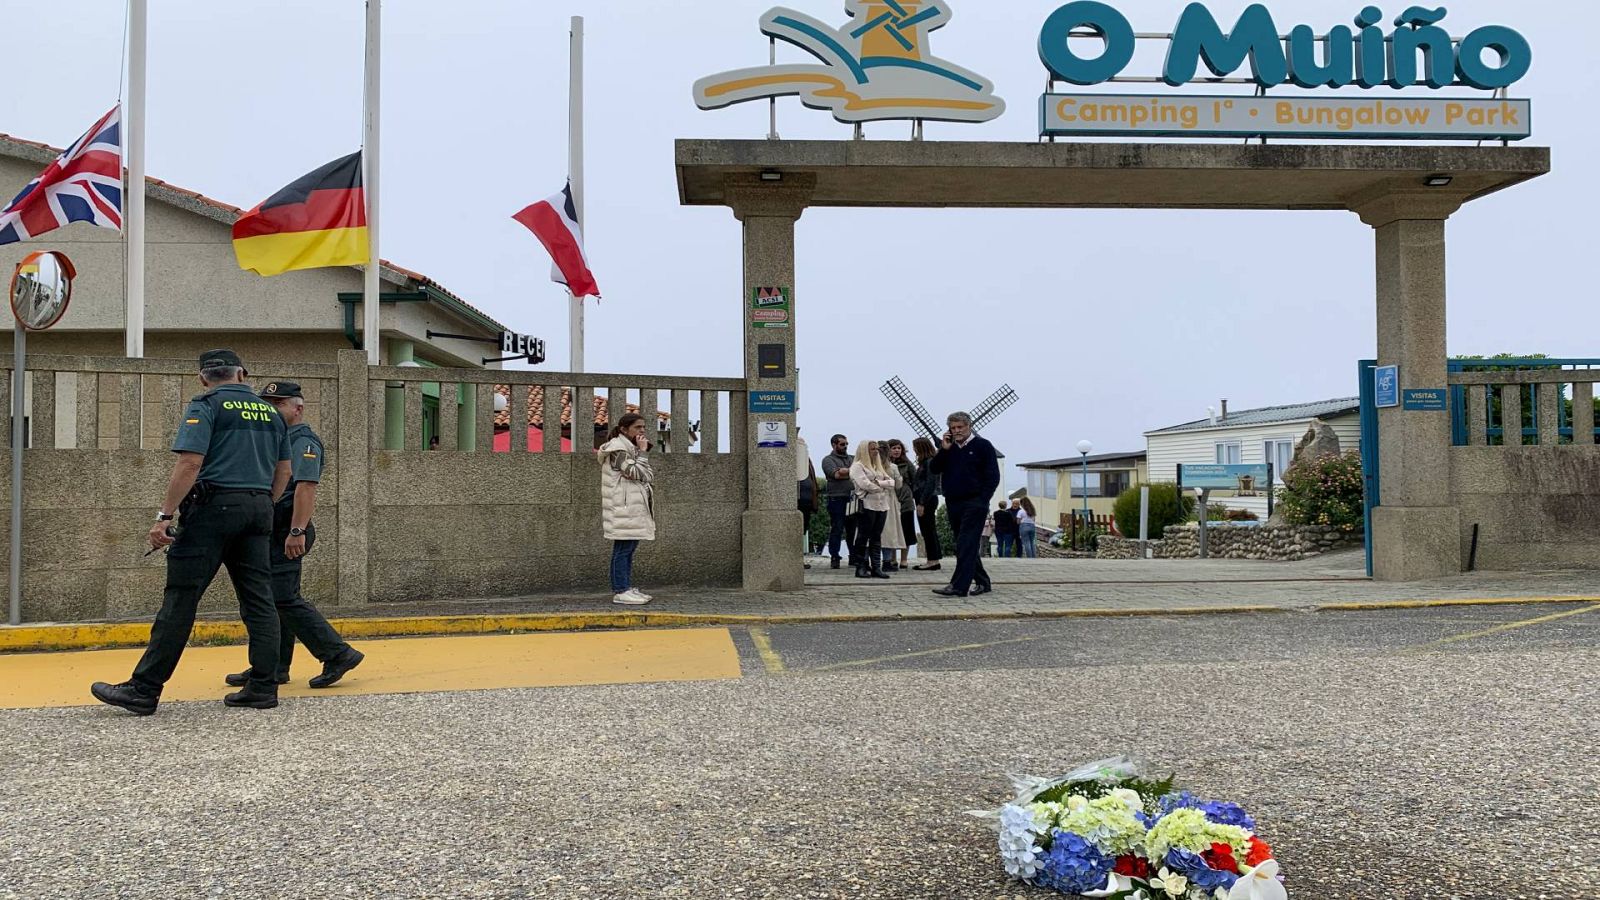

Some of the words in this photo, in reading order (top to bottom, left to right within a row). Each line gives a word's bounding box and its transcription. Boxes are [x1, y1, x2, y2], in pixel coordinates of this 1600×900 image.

[1038, 0, 1135, 86] O
[1162, 1, 1532, 90] Muiño
[1056, 98, 1198, 129] Camping
[1275, 100, 1431, 130] Bungalow
[1445, 101, 1519, 126] Park
[223, 401, 278, 415] GUARDIA
[241, 410, 271, 422] CIVIL
